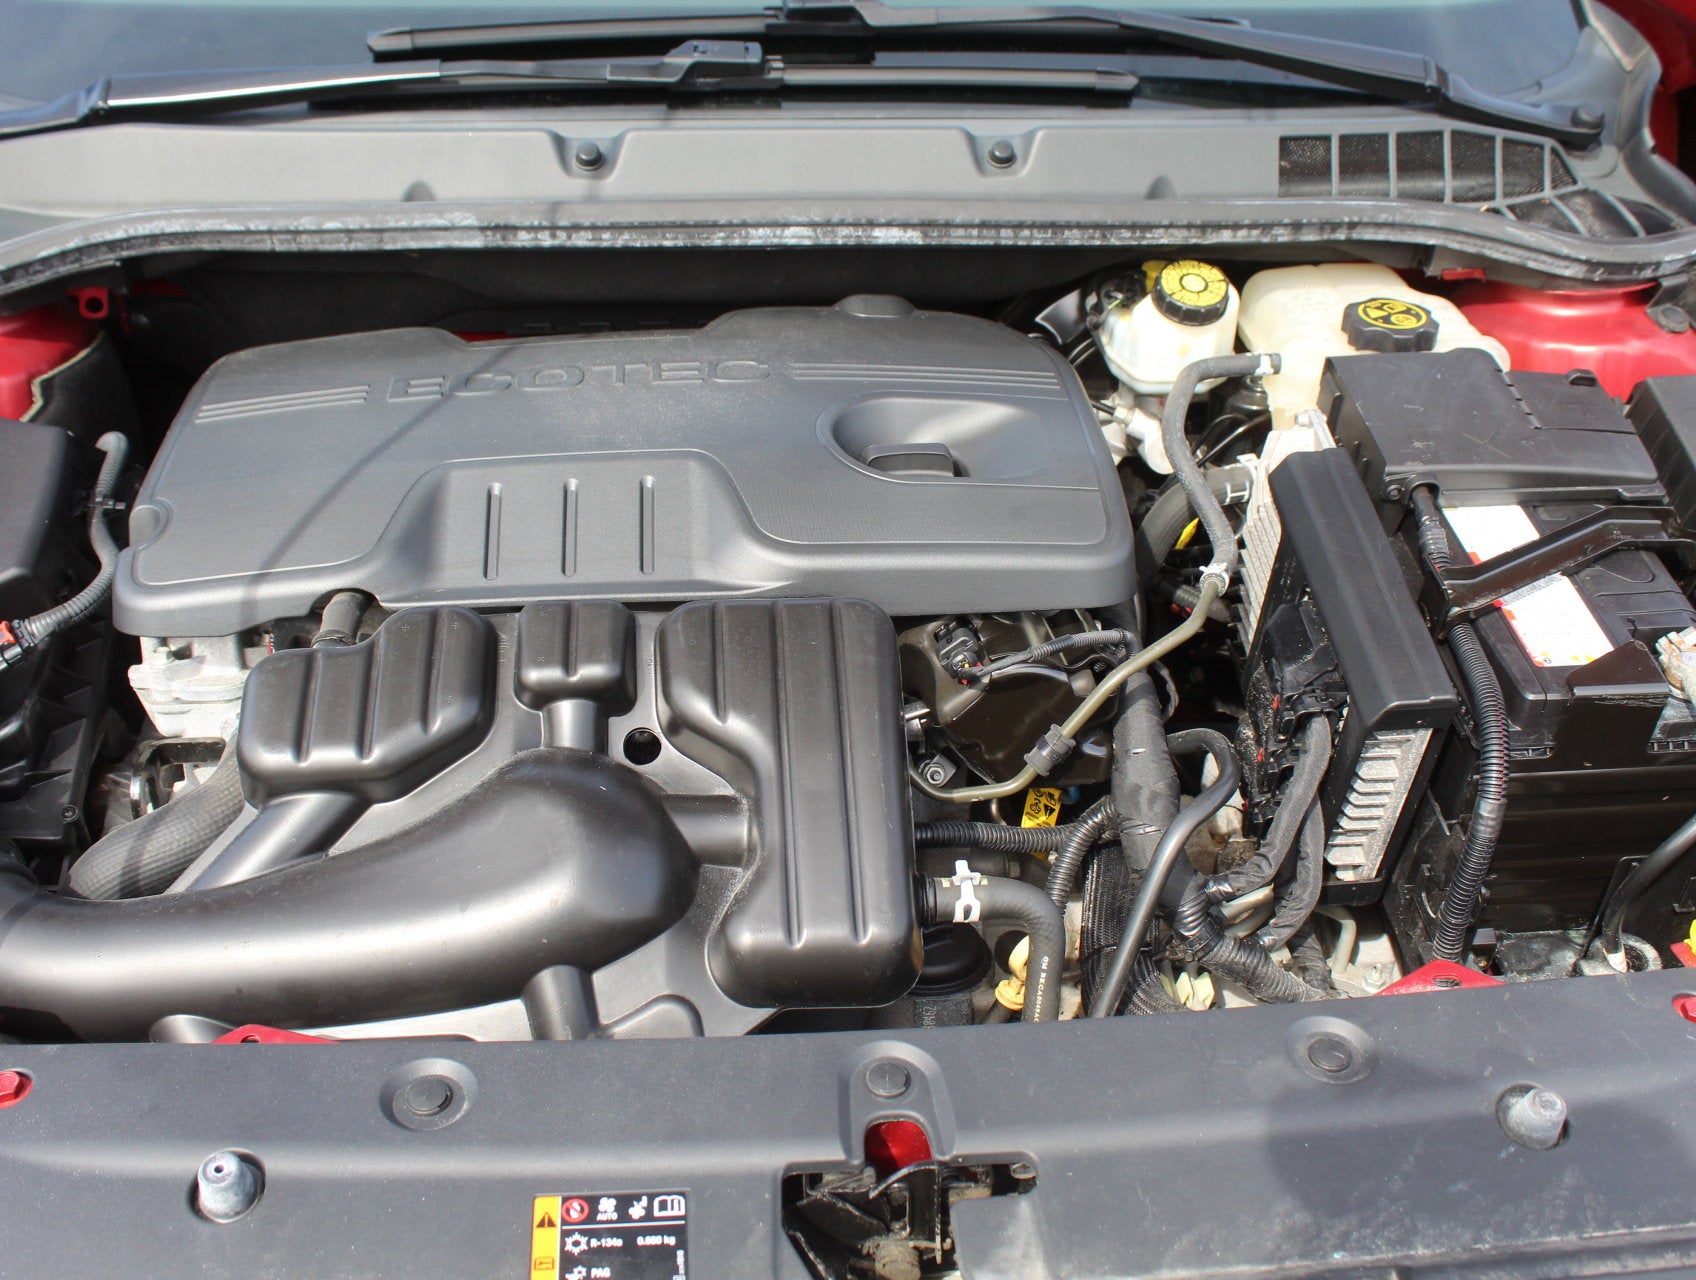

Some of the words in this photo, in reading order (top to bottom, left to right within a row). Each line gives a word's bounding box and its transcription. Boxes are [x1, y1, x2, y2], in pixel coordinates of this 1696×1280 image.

[386, 360, 771, 402] ECOTEC
[596, 1212, 618, 1221] AUTO
[590, 1237, 623, 1249] R-134a
[663, 1234, 676, 1246] kg
[590, 1266, 611, 1279] PAG
